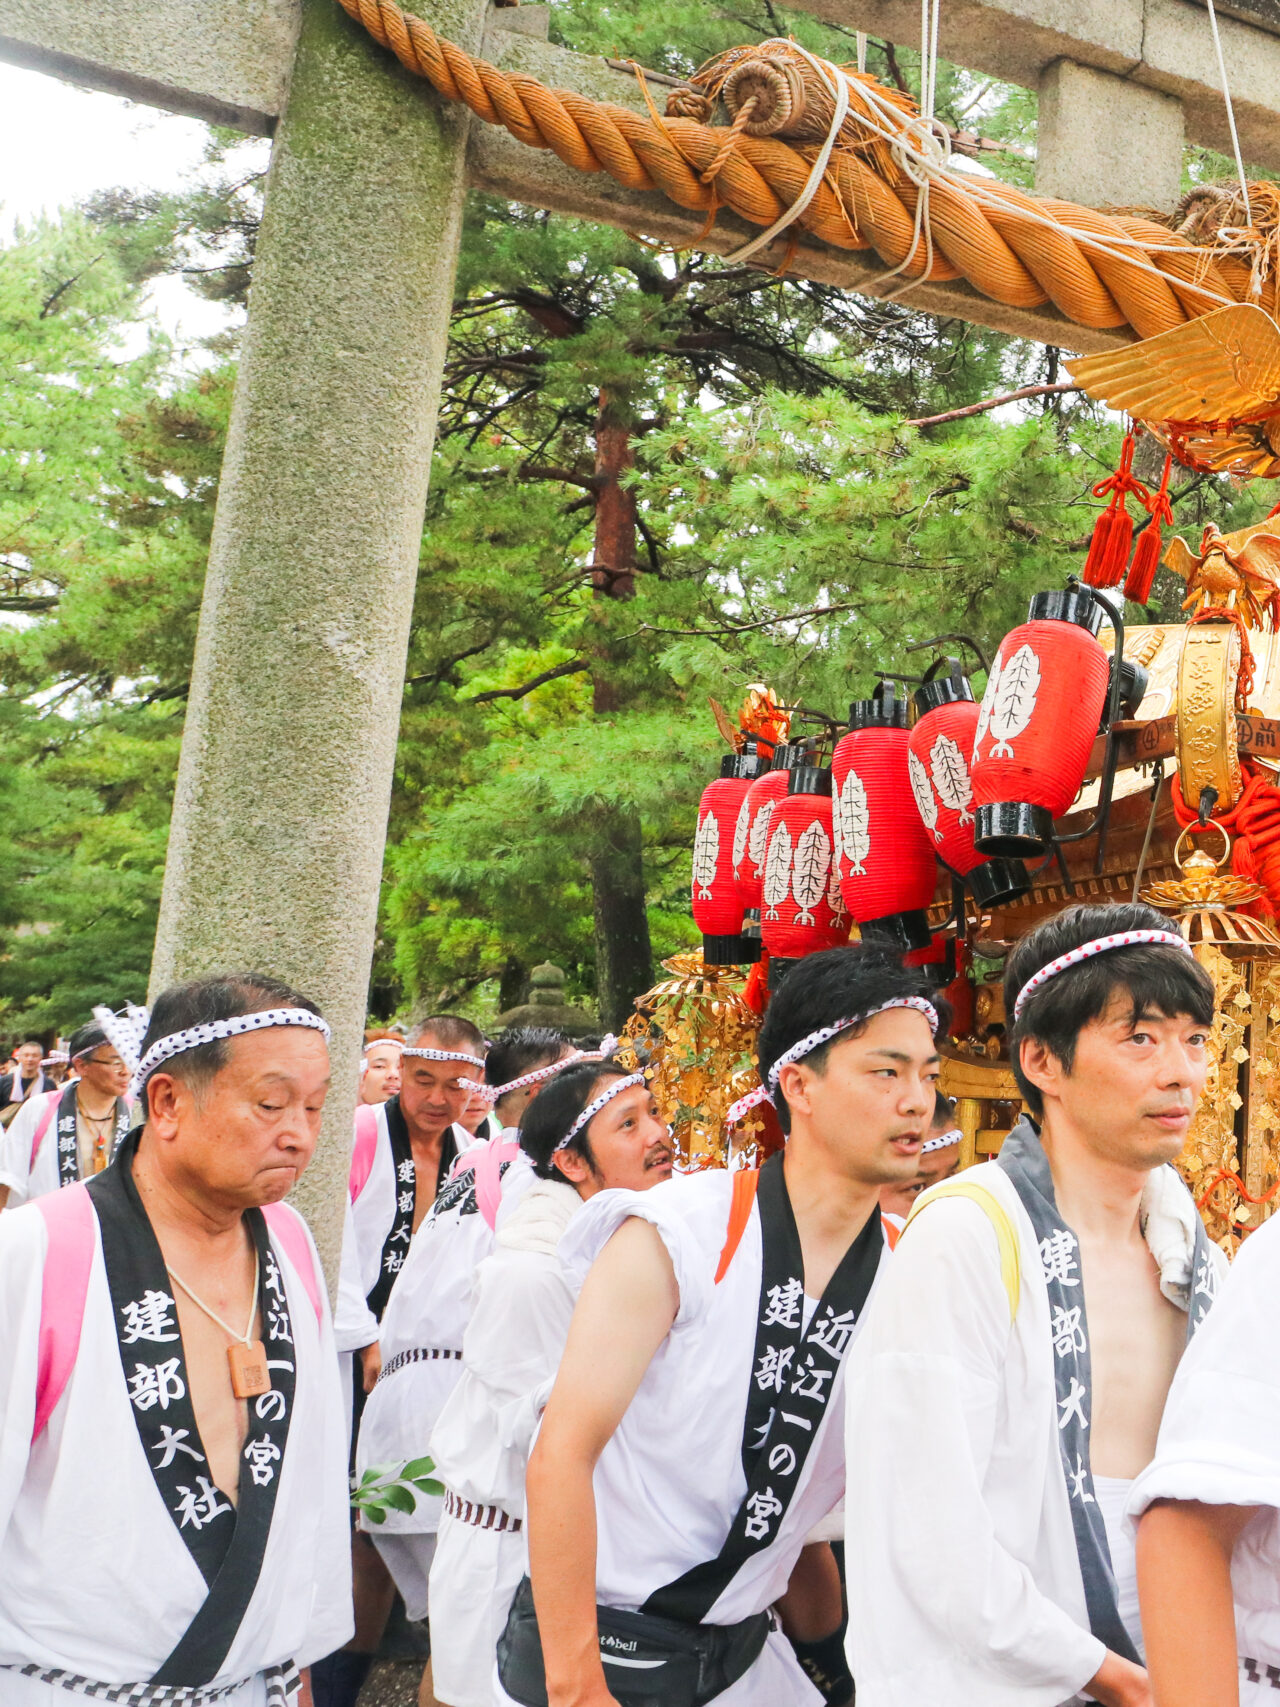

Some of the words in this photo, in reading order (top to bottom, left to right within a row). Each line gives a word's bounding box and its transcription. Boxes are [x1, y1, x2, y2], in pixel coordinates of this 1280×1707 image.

[383, 1158, 416, 1273] 建部大社
[120, 1289, 233, 1531] 建部大社
[743, 1304, 857, 1542] 近江一の宮
